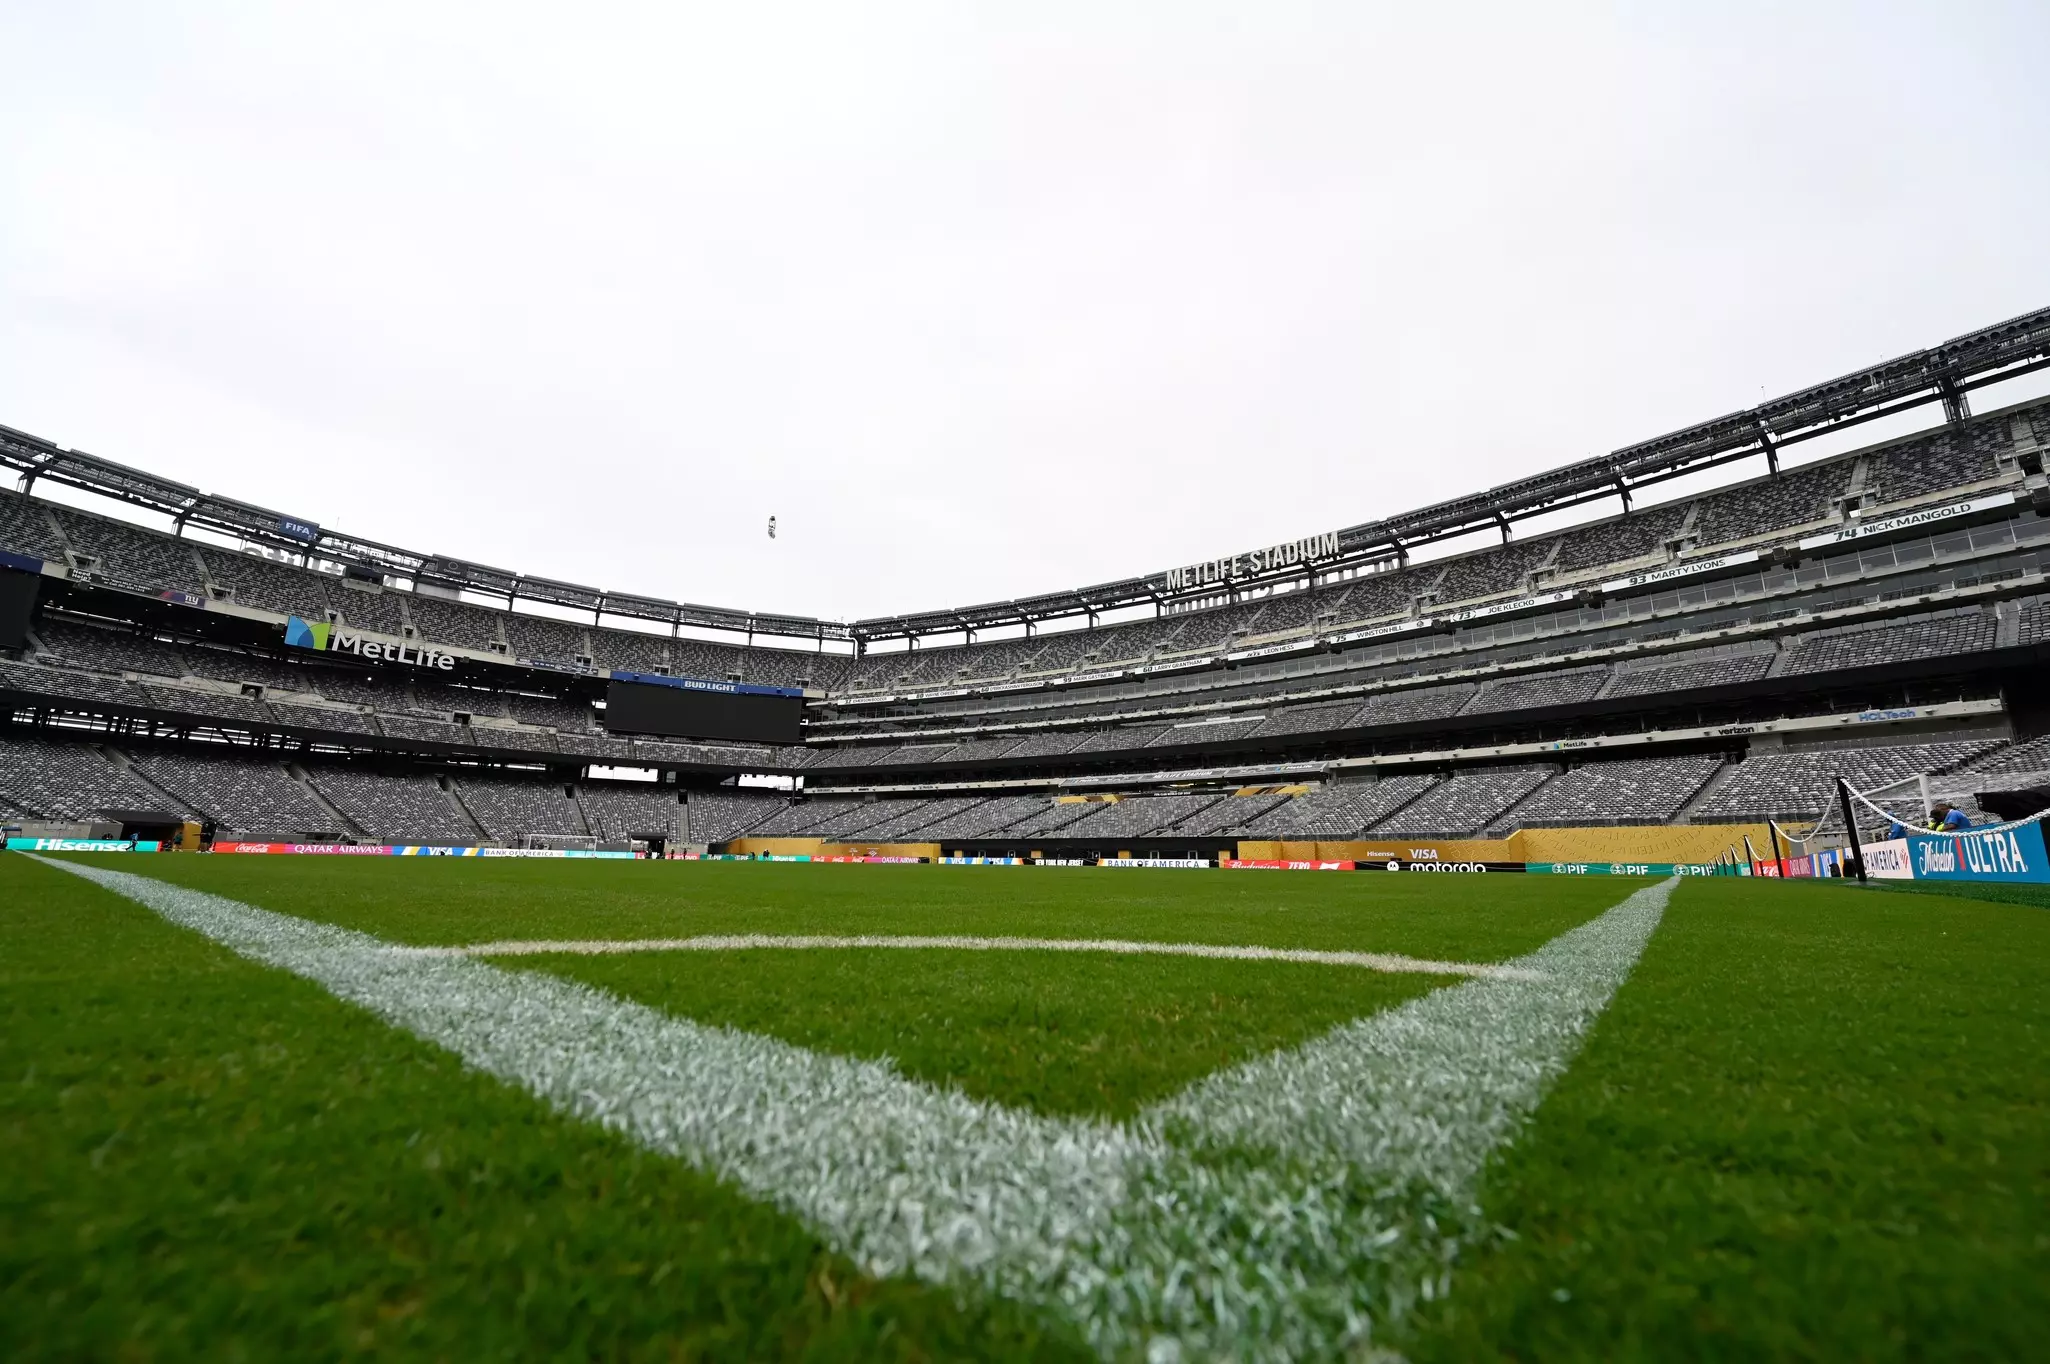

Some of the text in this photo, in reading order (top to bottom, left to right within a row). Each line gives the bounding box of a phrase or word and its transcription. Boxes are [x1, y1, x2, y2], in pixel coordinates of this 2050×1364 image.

[285, 521, 310, 535] FIFA
[1834, 504, 1971, 541] 74 NICK MANGOLD
[1166, 531, 1339, 590] METLIFE STADIUM
[1629, 559, 1725, 586] 93 MARTY LYONS
[1457, 599, 1535, 621] 73 JOE KLECKO
[1335, 625, 1403, 643] 75 WINSTON HILL
[331, 631, 455, 670] MetLife
[1154, 663, 1171, 671] LARRY
[1172, 659, 1202, 668] GRANTHAM
[684, 680, 736, 692] BUD LIGHT
[1859, 709, 1916, 721] HCLTech
[1718, 725, 1754, 735] verizon
[35, 838, 132, 852] Hisense
[235, 843, 270, 853] Coca-Cola
[294, 844, 383, 854] QATAR AIRWAYS
[428, 847, 453, 856] VISA
[1408, 849, 1438, 859] VISA
[1919, 831, 2028, 876] Michelob ULTRA
[1152, 860, 1200, 868] AMERICA
[1289, 861, 1311, 870] ZERO
[1870, 849, 1899, 872] AMERICA
[1410, 862, 1486, 873] motorola
[1567, 865, 1588, 875] PIF
[1627, 865, 1648, 876] PIF
